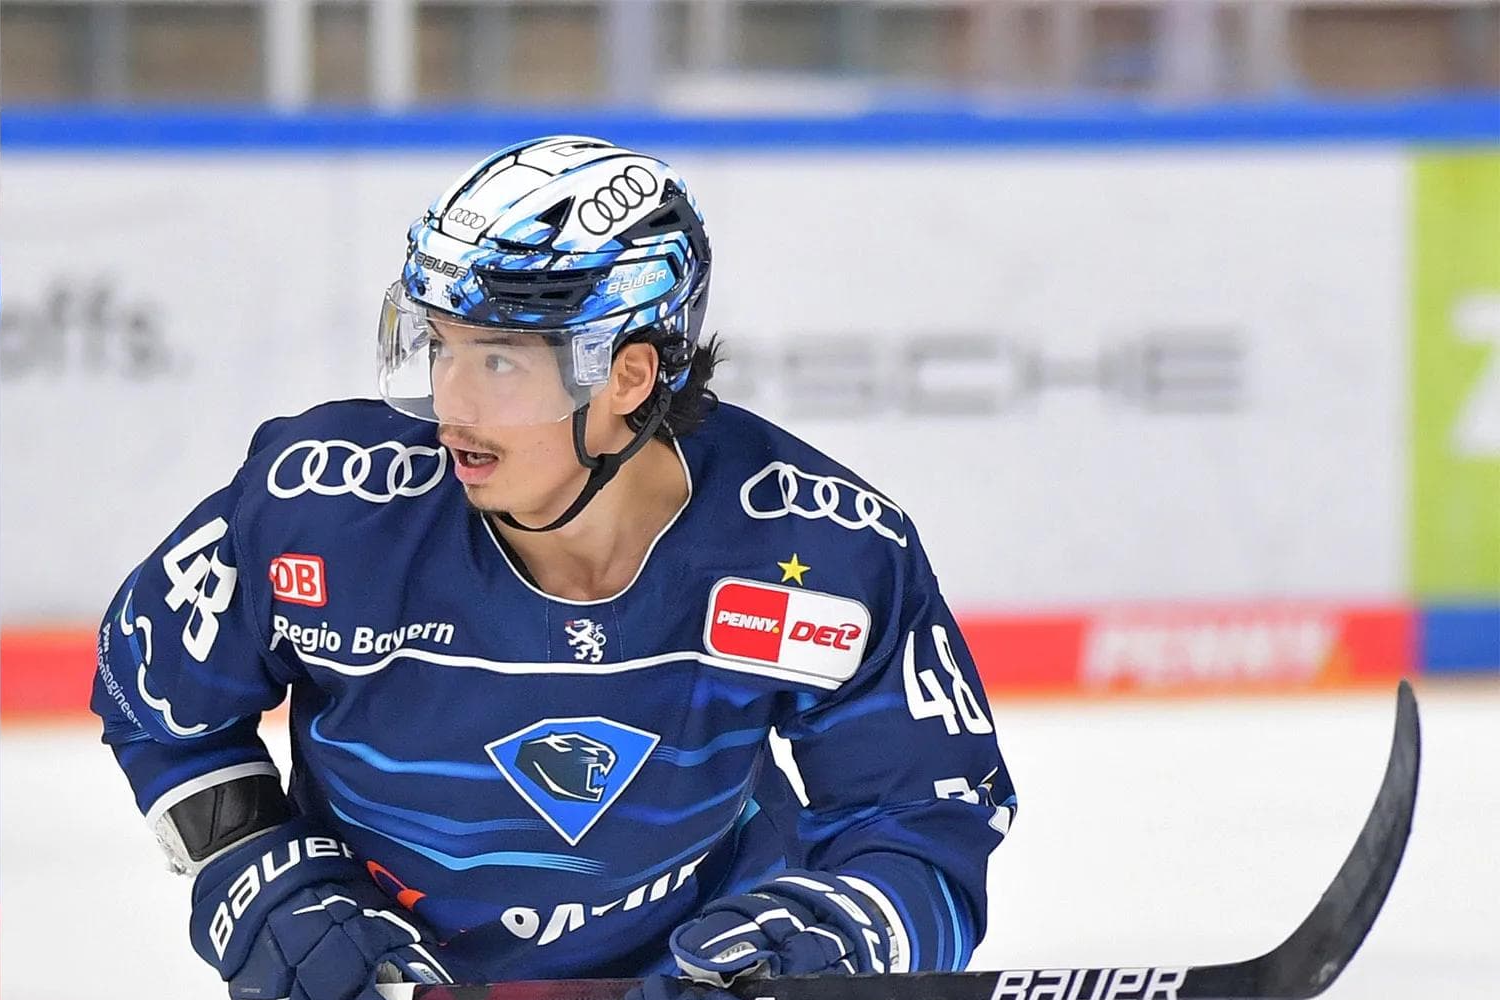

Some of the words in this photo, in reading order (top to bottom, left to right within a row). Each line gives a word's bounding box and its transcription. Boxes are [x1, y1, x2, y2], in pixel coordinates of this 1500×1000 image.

[414, 252, 469, 281] BAUER
[605, 270, 668, 295] BAUER
[276, 562, 317, 597] DB
[273, 614, 342, 654] Regio
[351, 621, 455, 655] Bayern
[902, 624, 994, 736] 48
